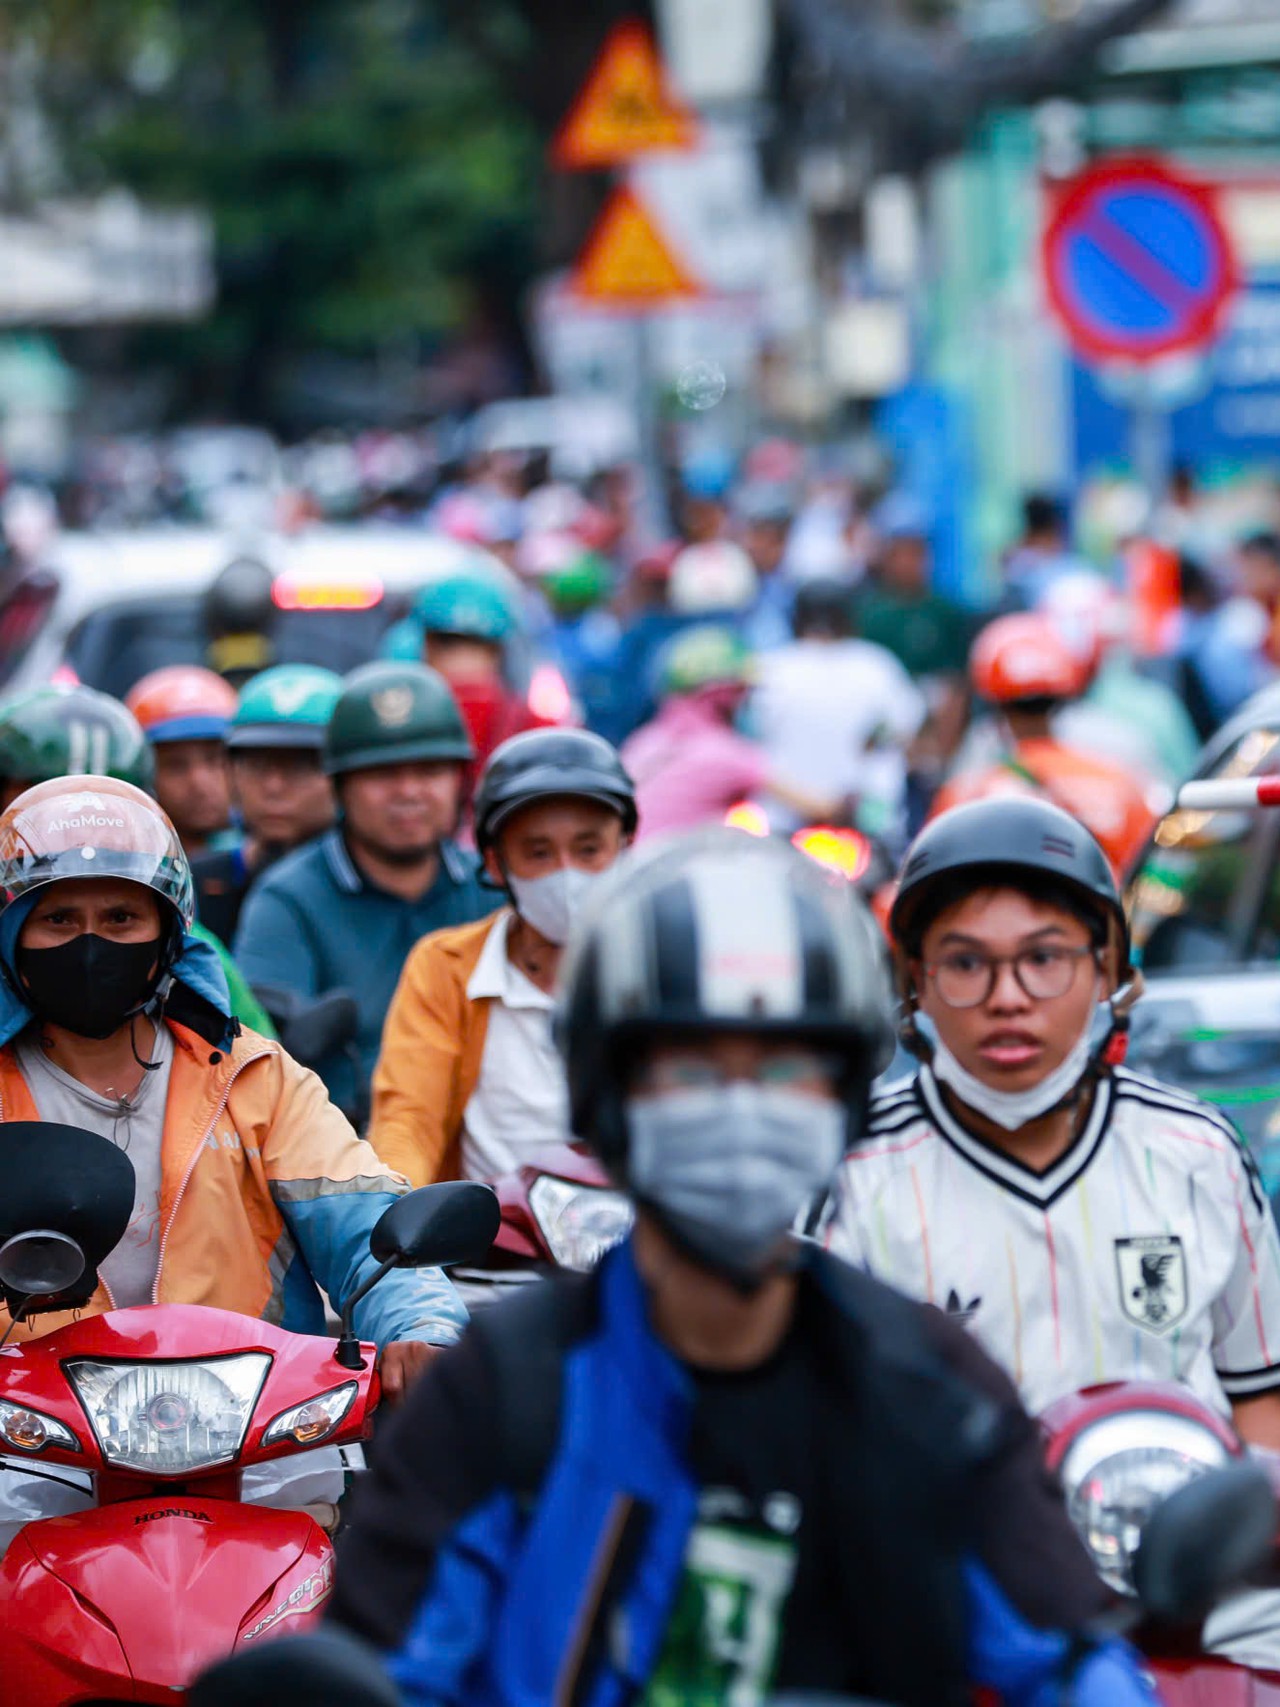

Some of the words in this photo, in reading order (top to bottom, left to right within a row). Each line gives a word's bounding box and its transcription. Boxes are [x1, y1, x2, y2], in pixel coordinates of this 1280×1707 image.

[47, 814, 126, 835] AhaMove
[134, 1508, 214, 1525] HONDA
[243, 1600, 288, 1639] WAVE
